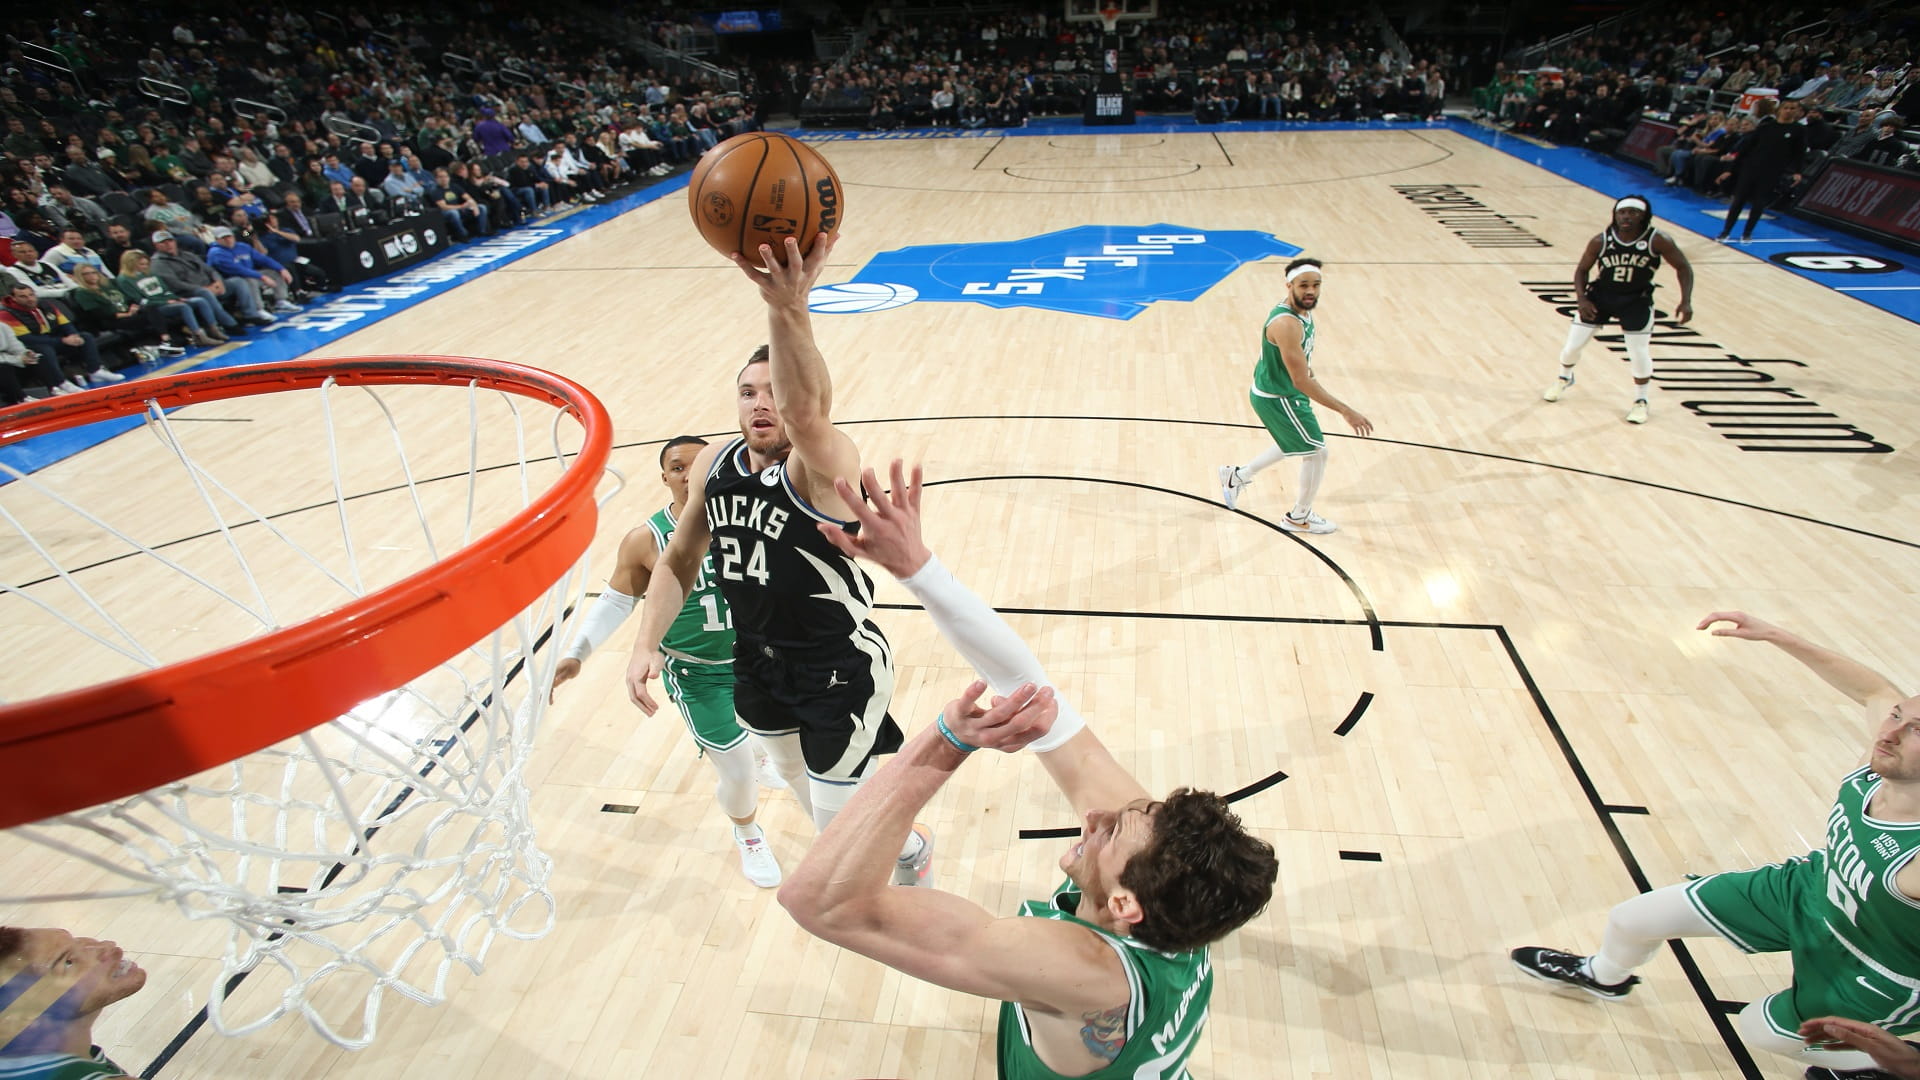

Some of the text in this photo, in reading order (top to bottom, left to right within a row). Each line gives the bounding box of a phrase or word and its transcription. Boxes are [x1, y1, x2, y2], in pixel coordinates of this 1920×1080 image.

[1813, 171, 1861, 208] THIS
[1842, 179, 1878, 213] IS
[961, 235, 1206, 295] BUCKS
[1602, 253, 1650, 268] BUCKS
[1613, 266, 1634, 283] 21
[1519, 281, 1895, 453] rv.forum
[719, 536, 770, 586] 24
[1826, 803, 1874, 902] OSTON
[1870, 838, 1891, 860] PRINT
[1878, 832, 1901, 857] VISTA
